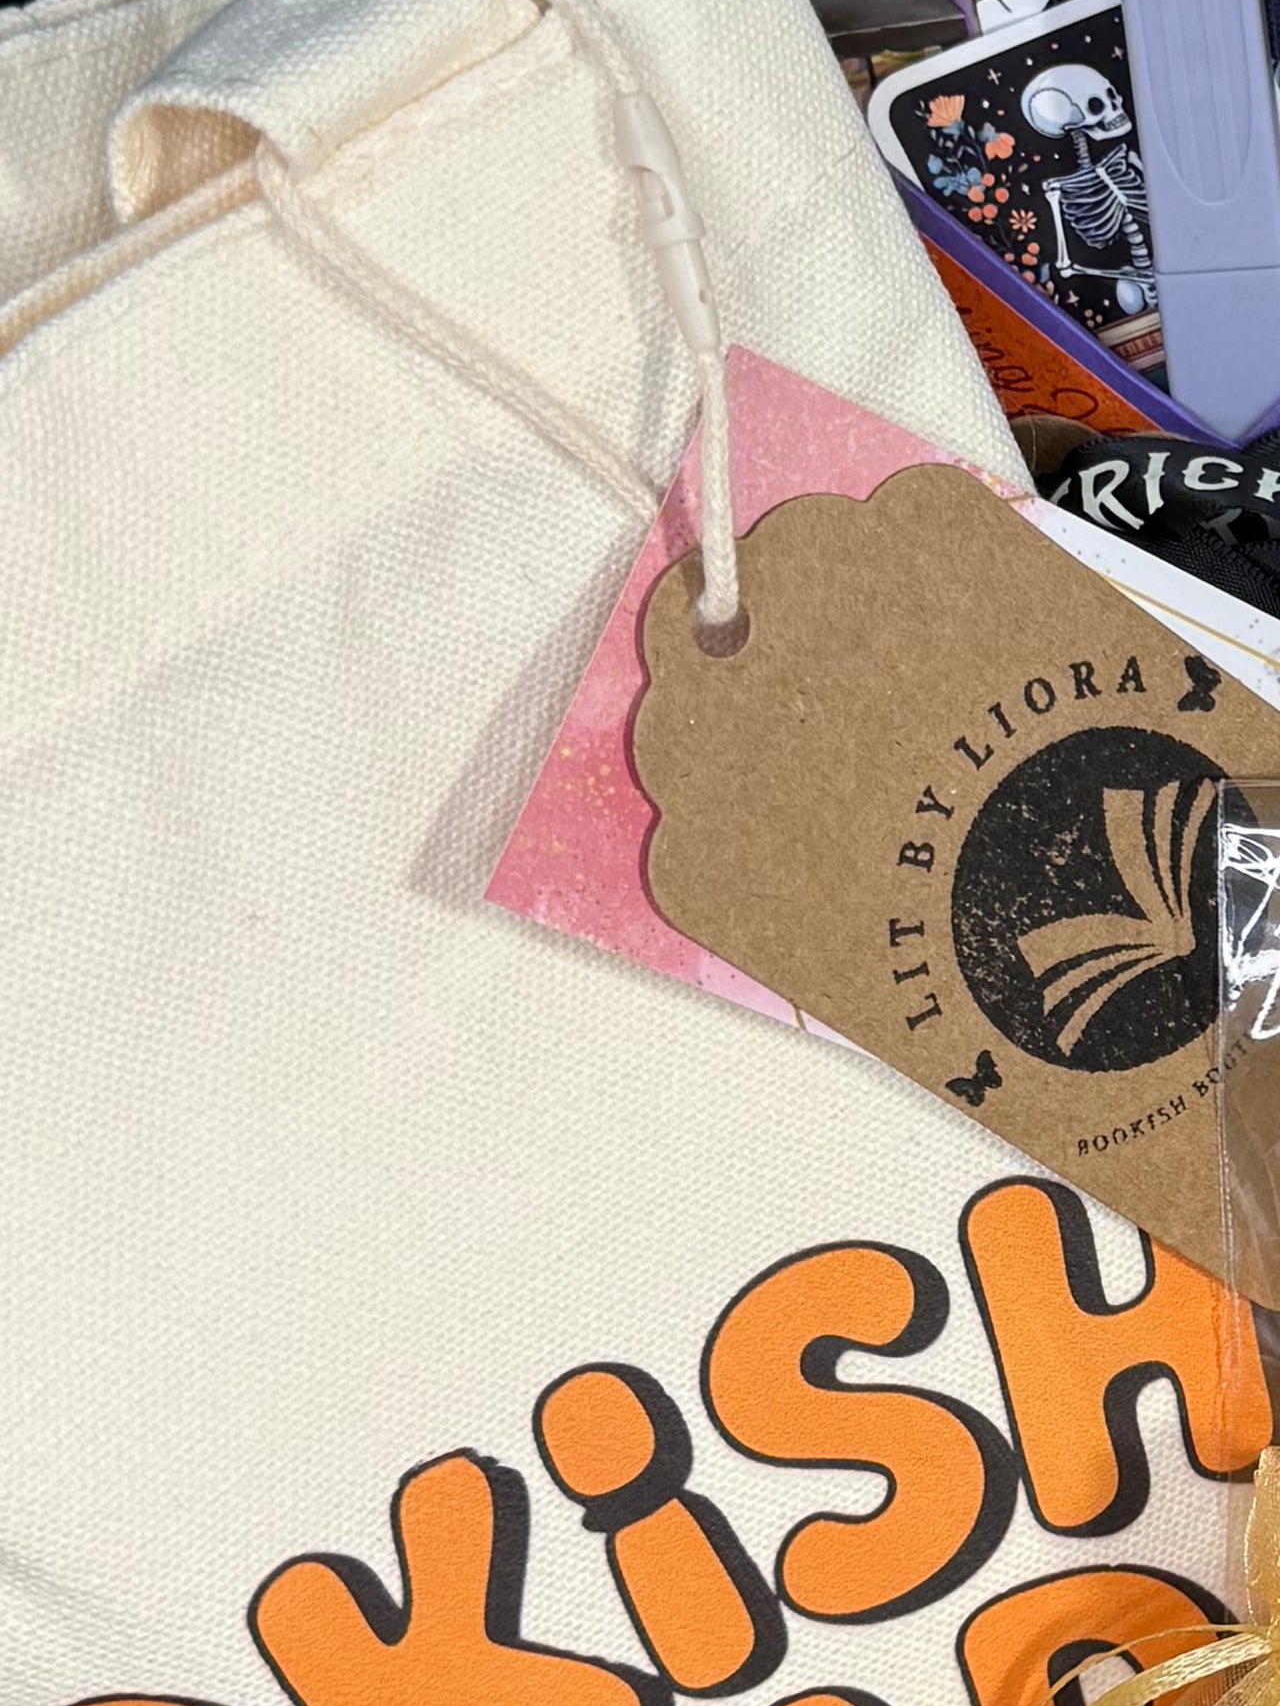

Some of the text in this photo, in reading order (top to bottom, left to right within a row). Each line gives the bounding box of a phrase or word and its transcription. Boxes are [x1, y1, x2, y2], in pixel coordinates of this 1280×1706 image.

[888, 654, 1147, 1032] LIT BY LIORA
